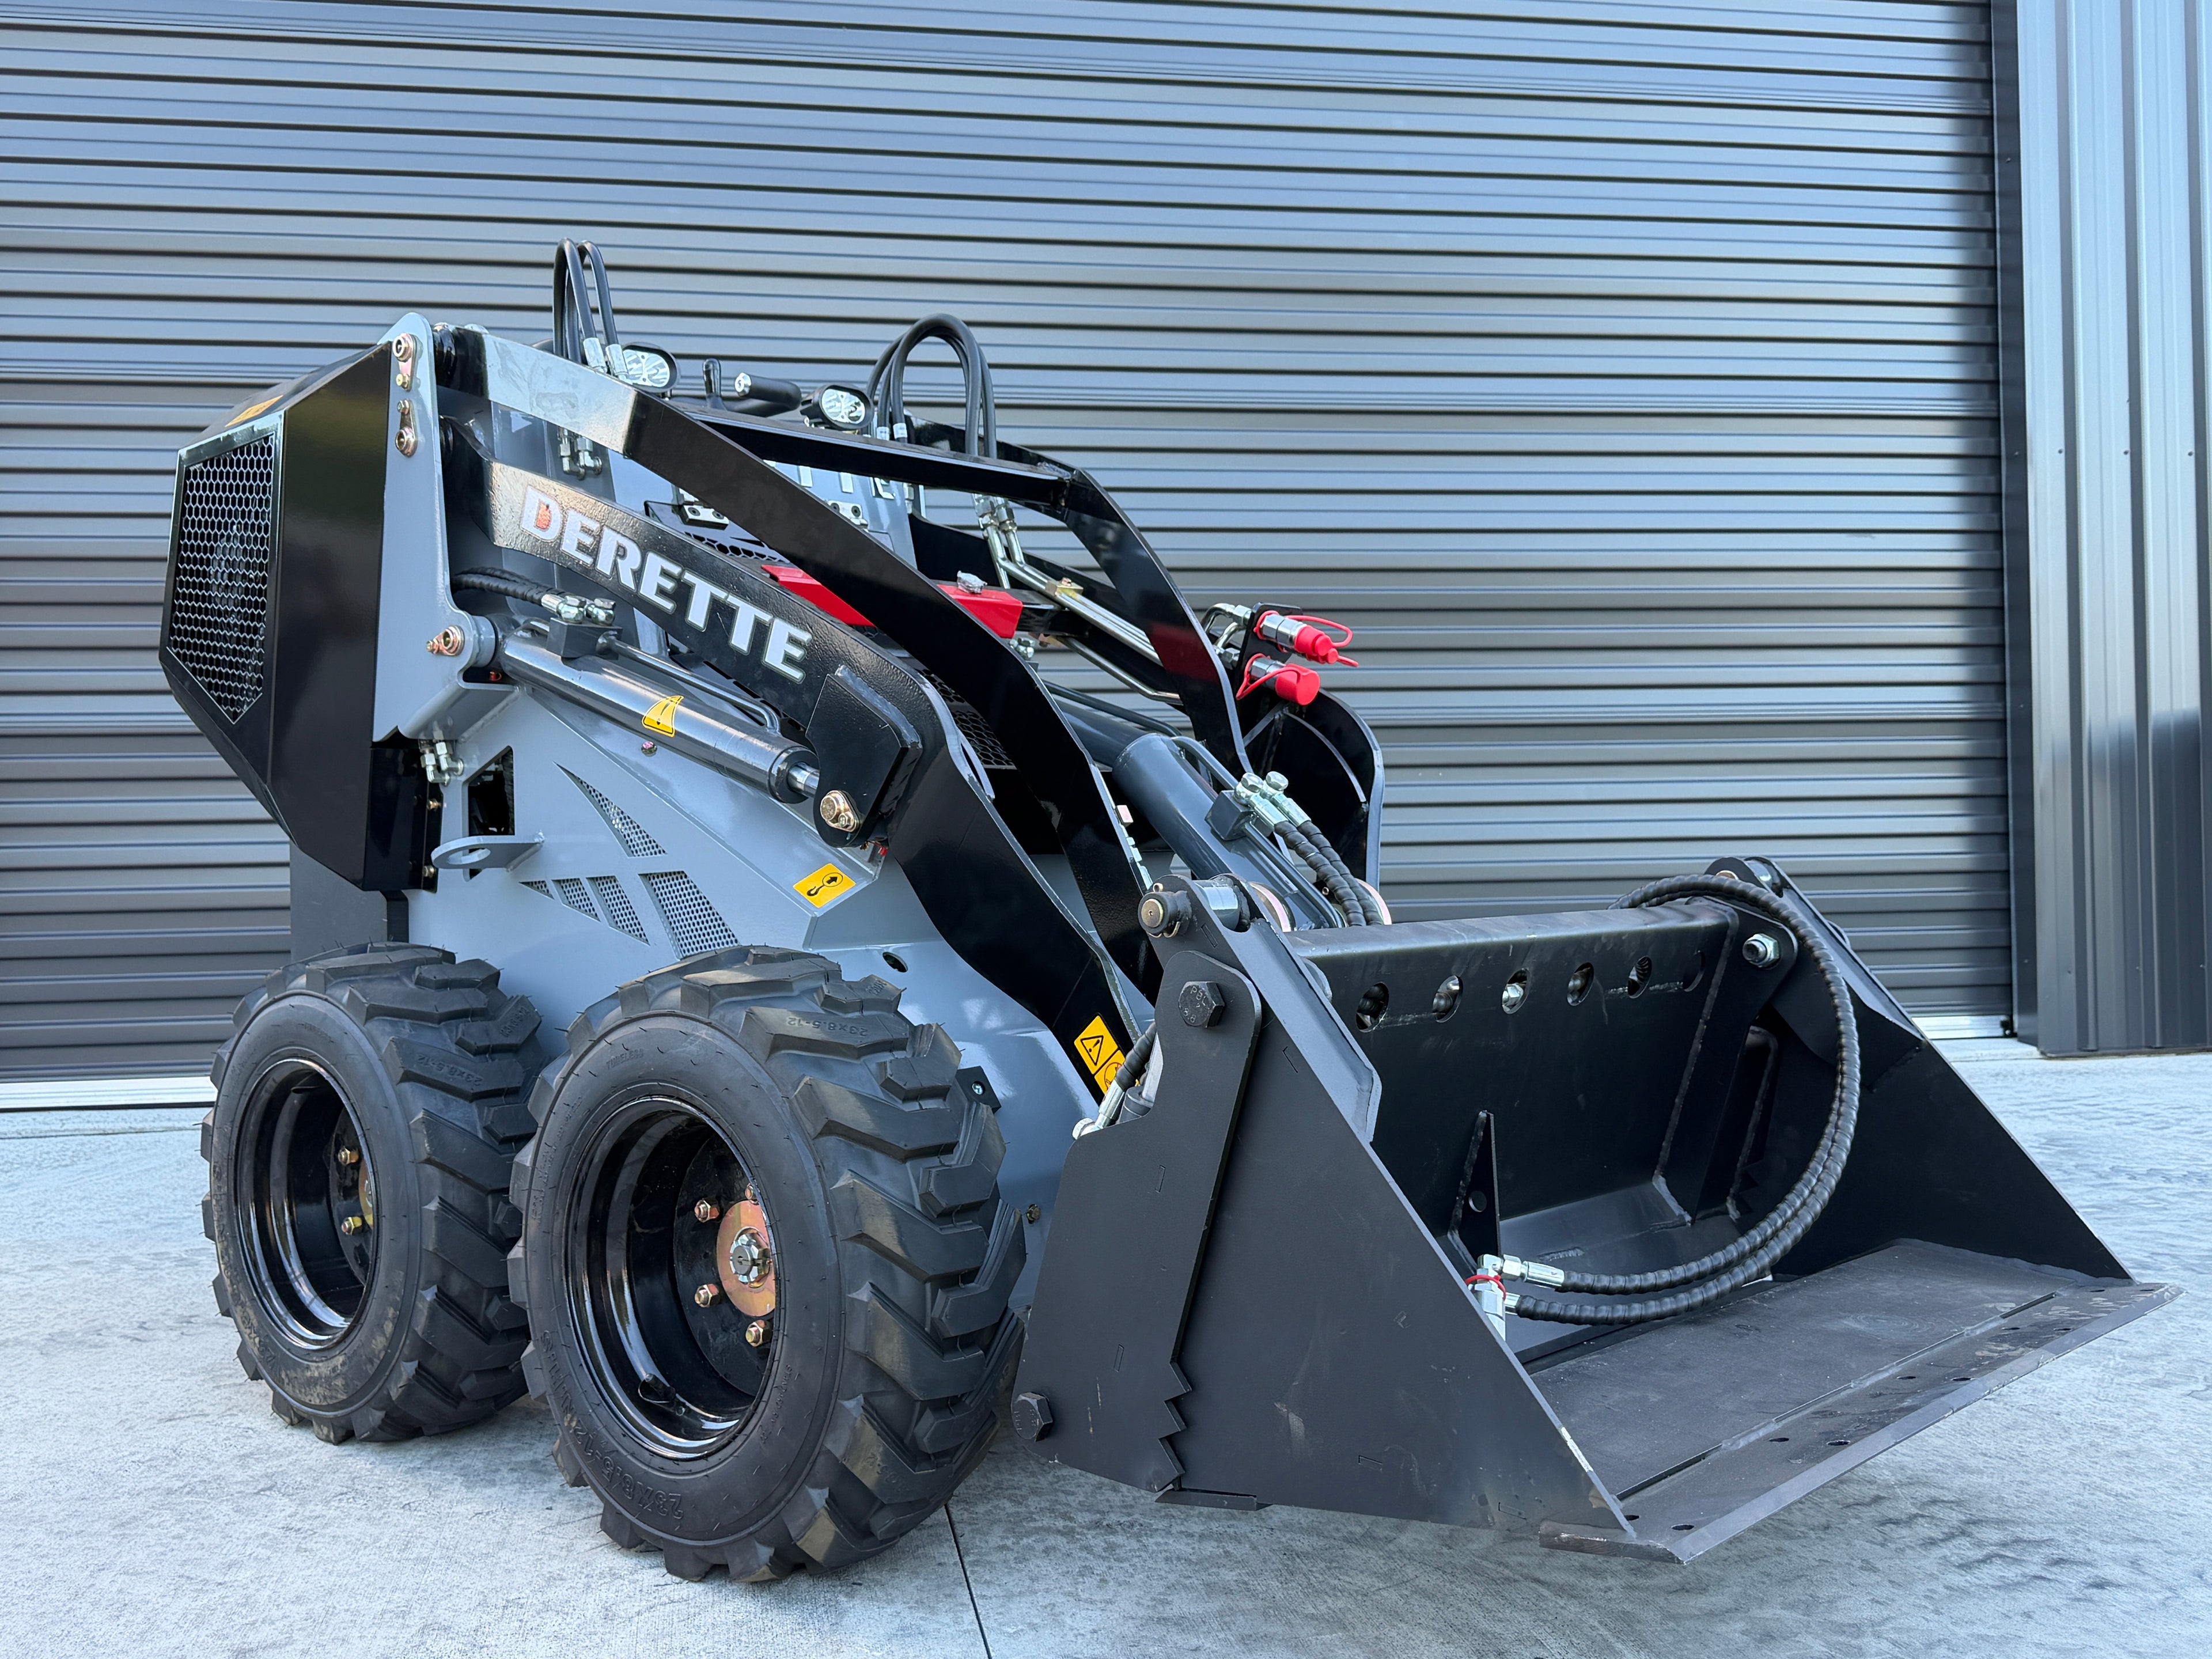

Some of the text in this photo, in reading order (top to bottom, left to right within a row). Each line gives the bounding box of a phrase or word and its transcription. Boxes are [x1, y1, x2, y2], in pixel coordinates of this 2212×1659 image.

[520, 486, 813, 684] DERETTE
[787, 1017, 868, 1036] 23x8.5-12
[416, 1054, 483, 1086] 23x8.5-12
[574, 1418, 684, 1520] 23X8.5-12
